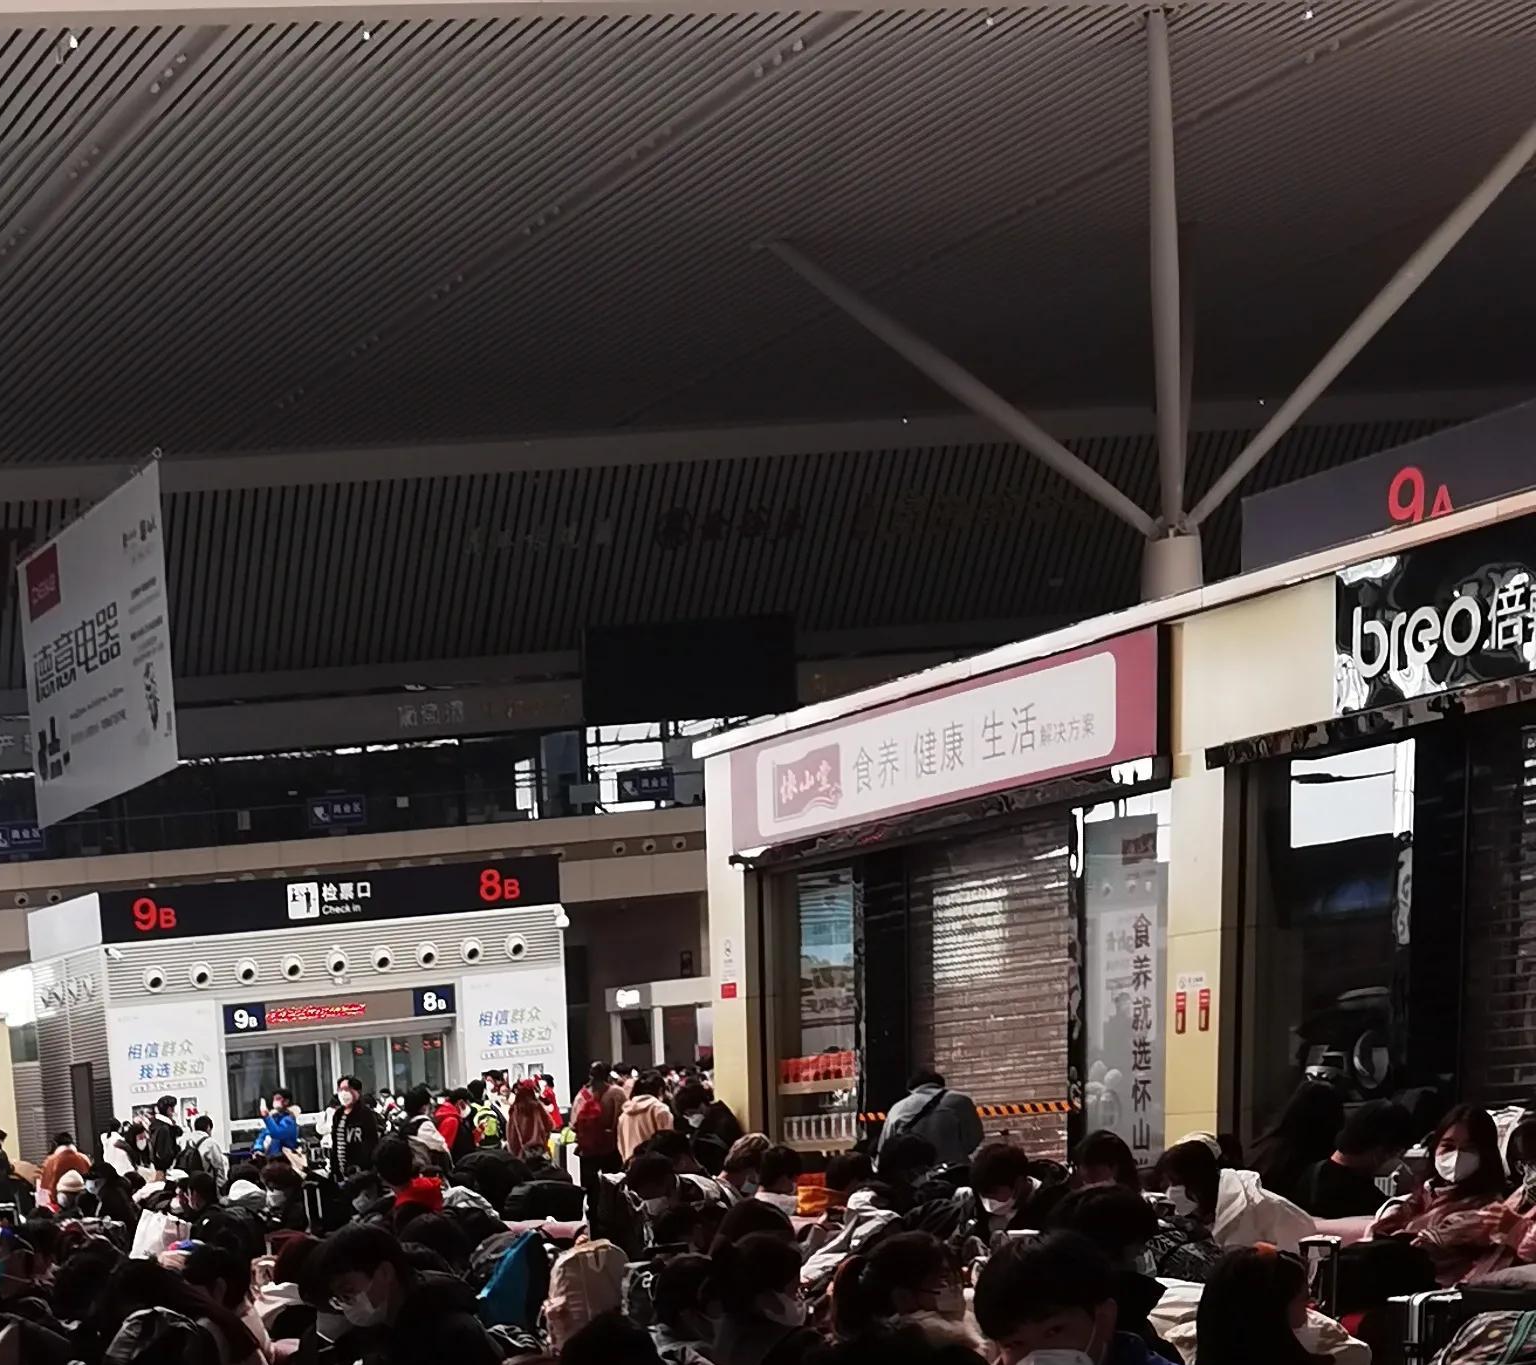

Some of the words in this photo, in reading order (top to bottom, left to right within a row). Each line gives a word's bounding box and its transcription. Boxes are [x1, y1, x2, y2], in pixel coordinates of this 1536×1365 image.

[1388, 466, 1454, 523] 9A
[1352, 594, 1482, 678] breo
[32, 601, 122, 703] 德意电器
[851, 739, 901, 794] 食养
[913, 721, 965, 778] 健康
[981, 702, 1038, 762] 生活
[1039, 714, 1096, 747] 解决方案
[321, 881, 372, 902] 检票口
[478, 868, 521, 902] 8B
[132, 897, 177, 931] 9B
[321, 904, 351, 915] Check
[422, 991, 447, 1011] 8B
[233, 1008, 258, 1029] 9B
[478, 1006, 542, 1027] 相信群众
[489, 1026, 552, 1047] 我选移动
[128, 1039, 194, 1060] 相信群众
[138, 1060, 204, 1080] 我选移动
